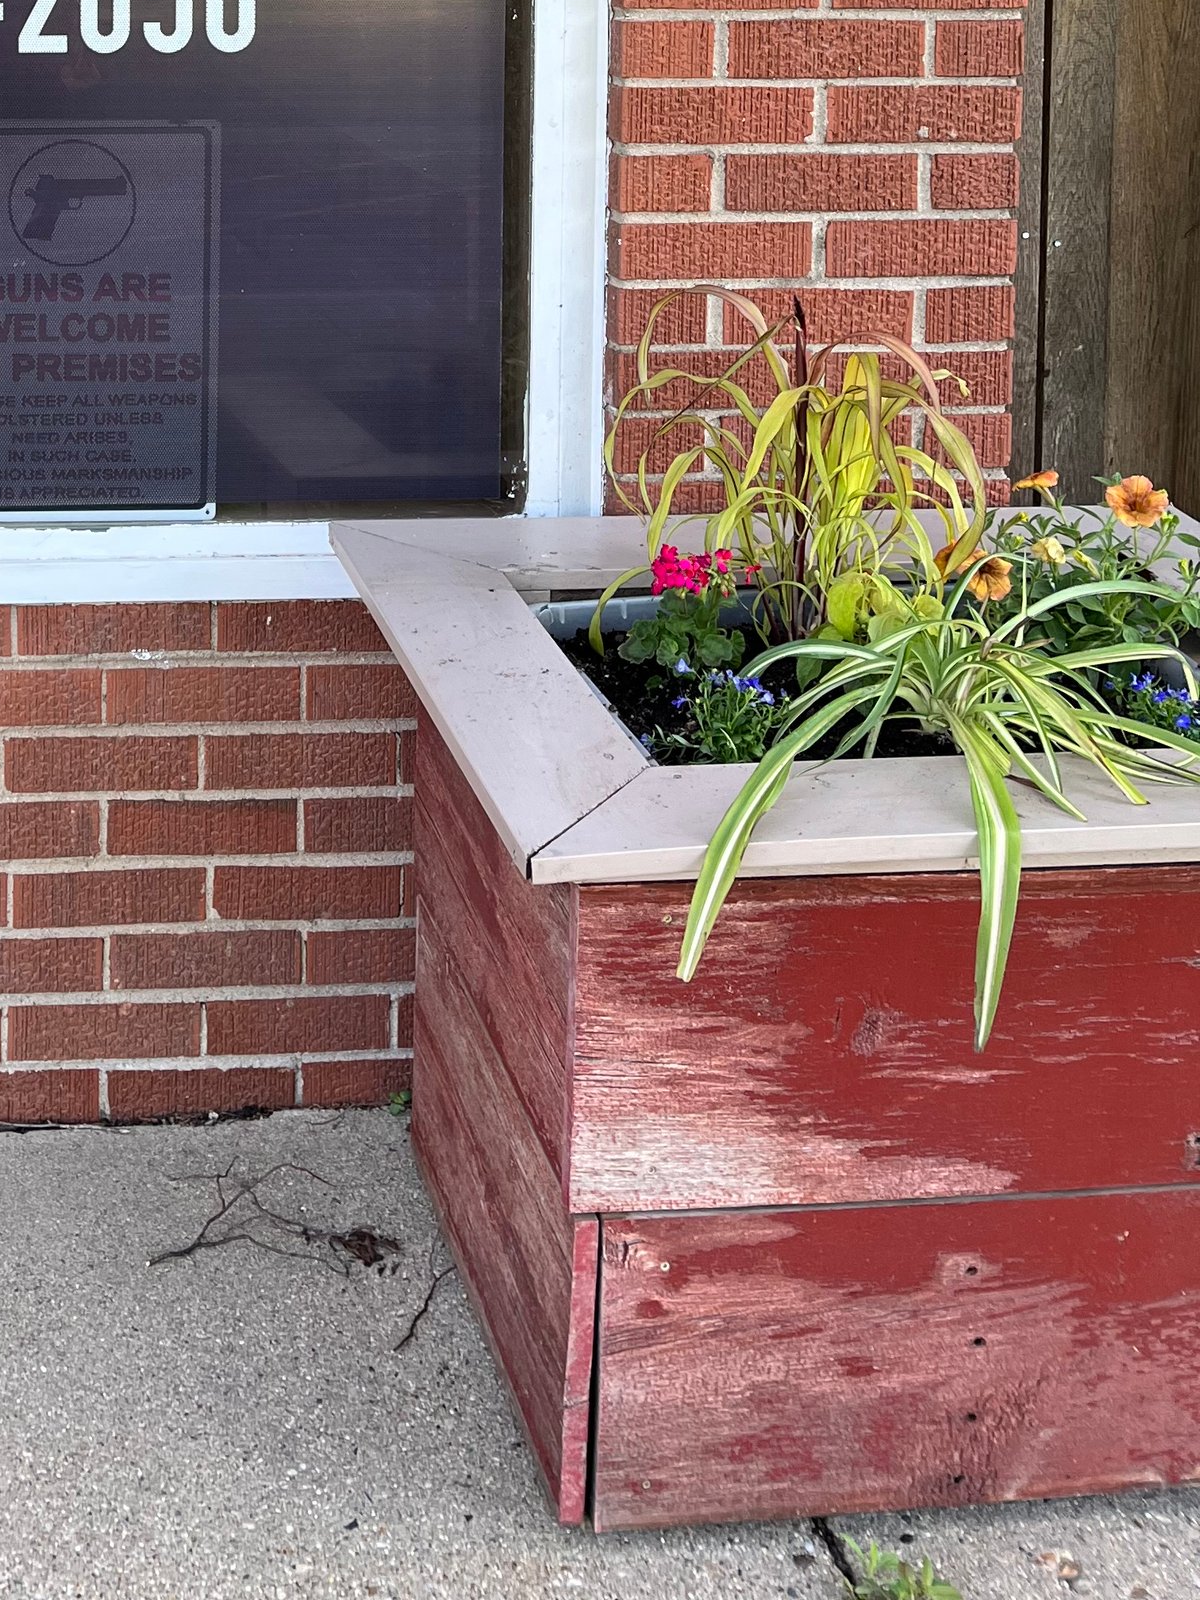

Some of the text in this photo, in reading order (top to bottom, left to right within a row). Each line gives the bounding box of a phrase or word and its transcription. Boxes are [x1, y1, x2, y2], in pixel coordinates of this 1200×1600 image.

[93, 273, 172, 301] ARE
[12, 353, 202, 383] PREMISES
[22, 394, 69, 408] KEEP
[73, 394, 103, 407] ALL
[108, 393, 198, 407] WEAPONS
[95, 412, 163, 426] UNLESS
[12, 432, 60, 446] NEED
[8, 451, 25, 464] IN
[31, 450, 80, 464] SUCH
[51, 467, 194, 482] MARKSMANSHIP
